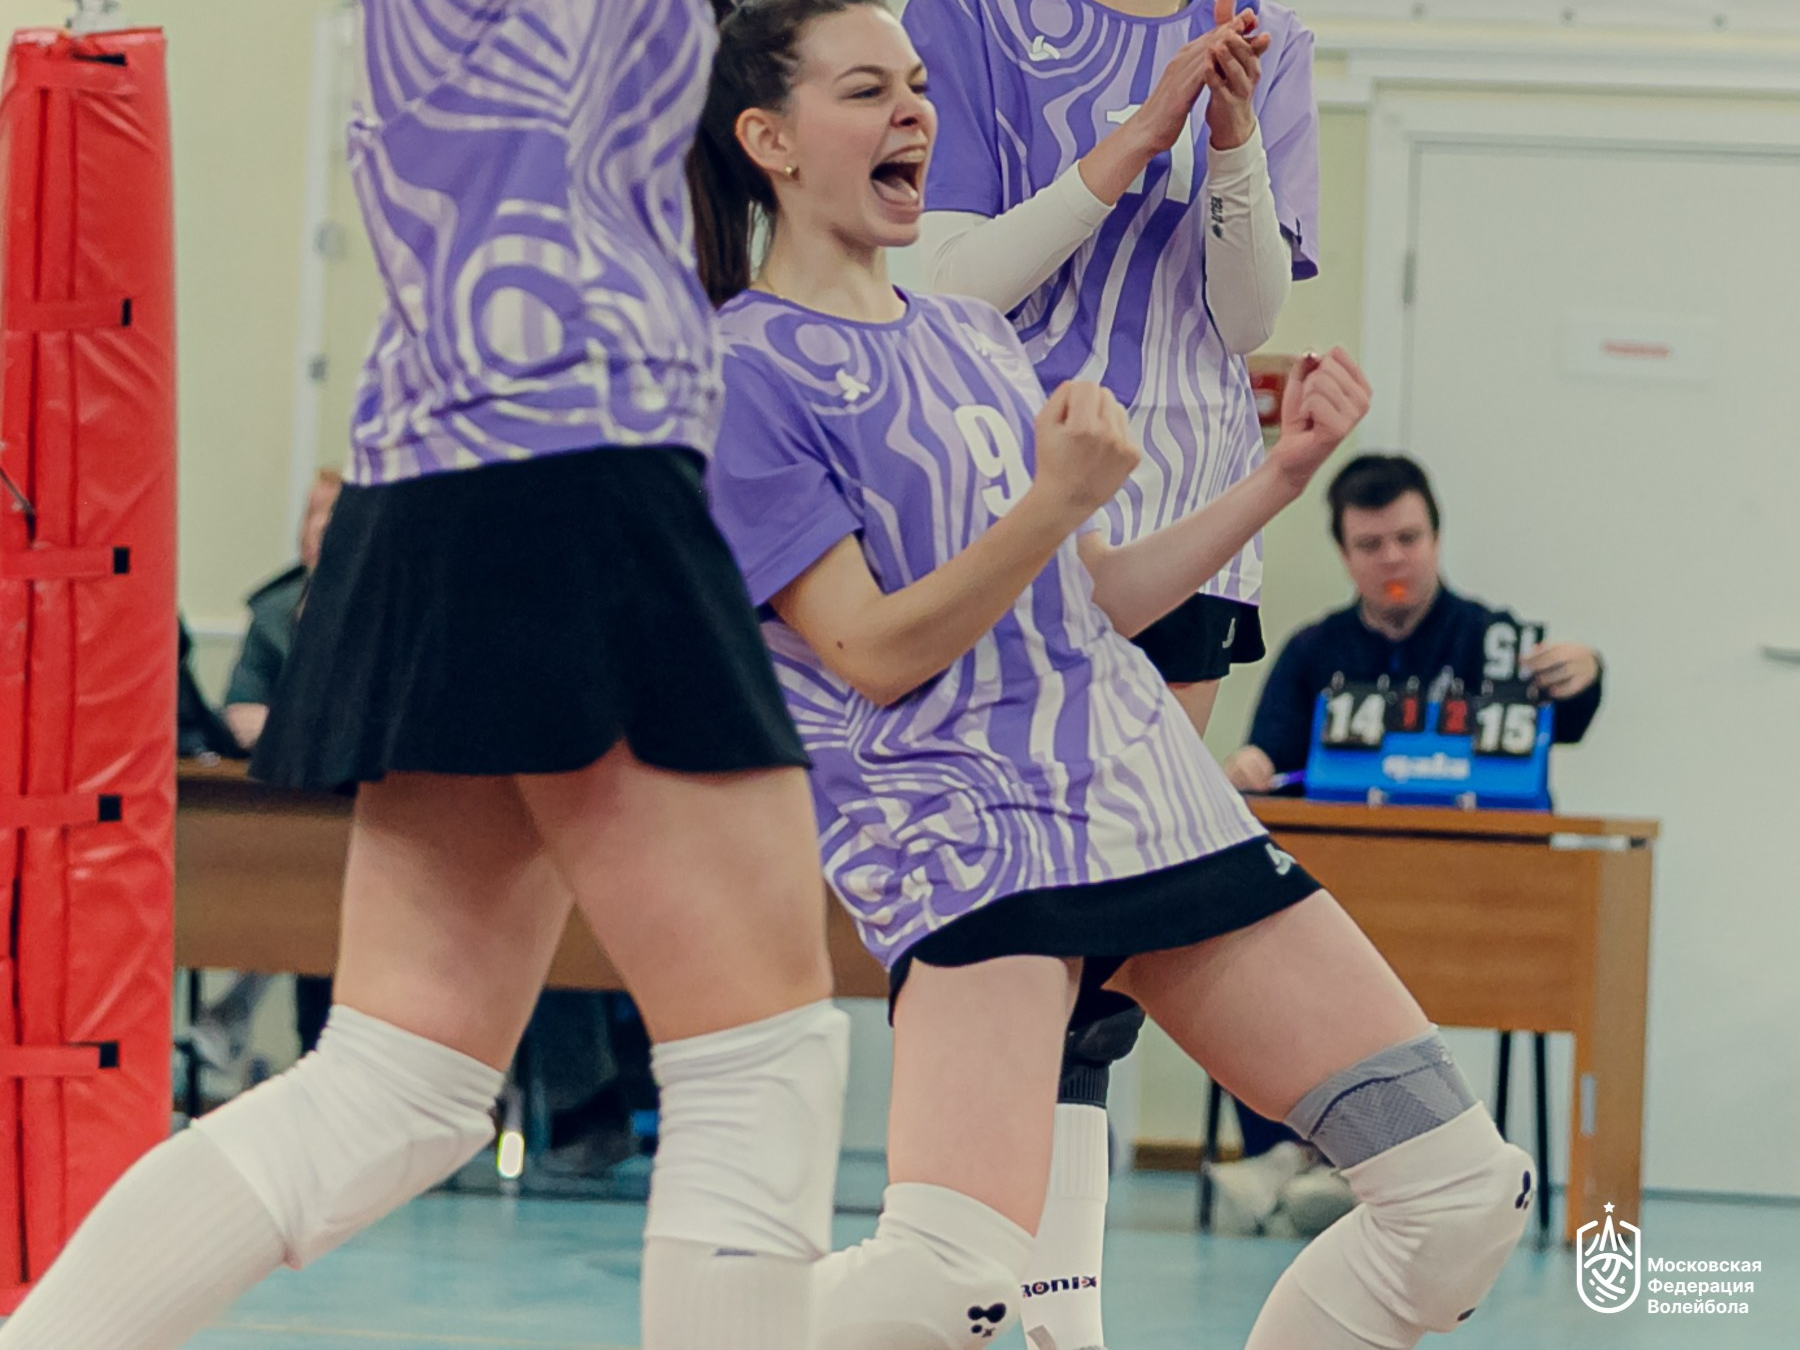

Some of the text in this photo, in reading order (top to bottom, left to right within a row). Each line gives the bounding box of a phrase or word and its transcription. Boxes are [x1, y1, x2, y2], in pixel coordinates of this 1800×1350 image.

[953, 404, 1033, 518] 9
[1326, 693, 1386, 745] 14
[1476, 703, 1537, 754] 15
